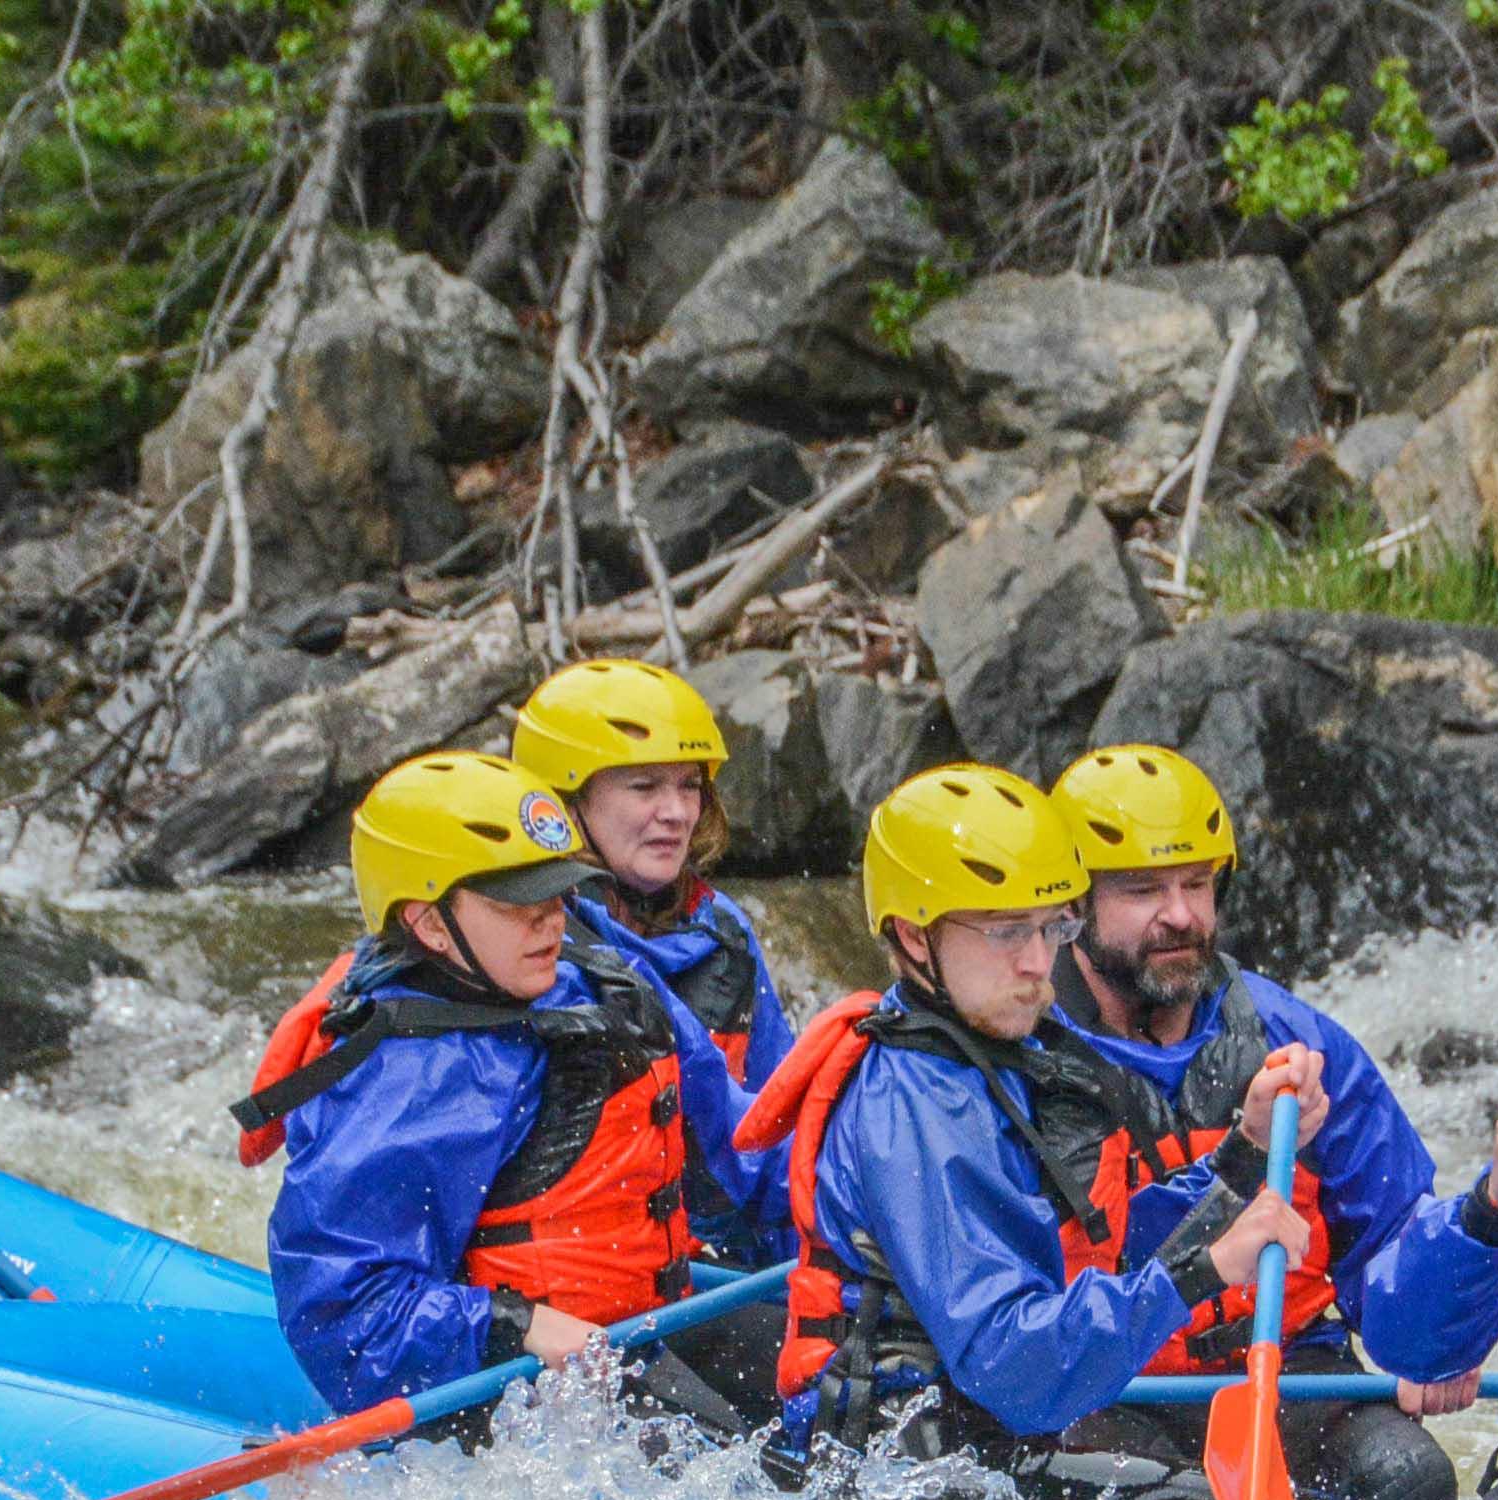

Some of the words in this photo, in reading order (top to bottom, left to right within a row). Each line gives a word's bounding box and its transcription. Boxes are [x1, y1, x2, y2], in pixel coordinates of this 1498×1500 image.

[678, 741, 712, 751] NRS
[1151, 842, 1194, 856] NRS
[1034, 880, 1072, 896] NRS
